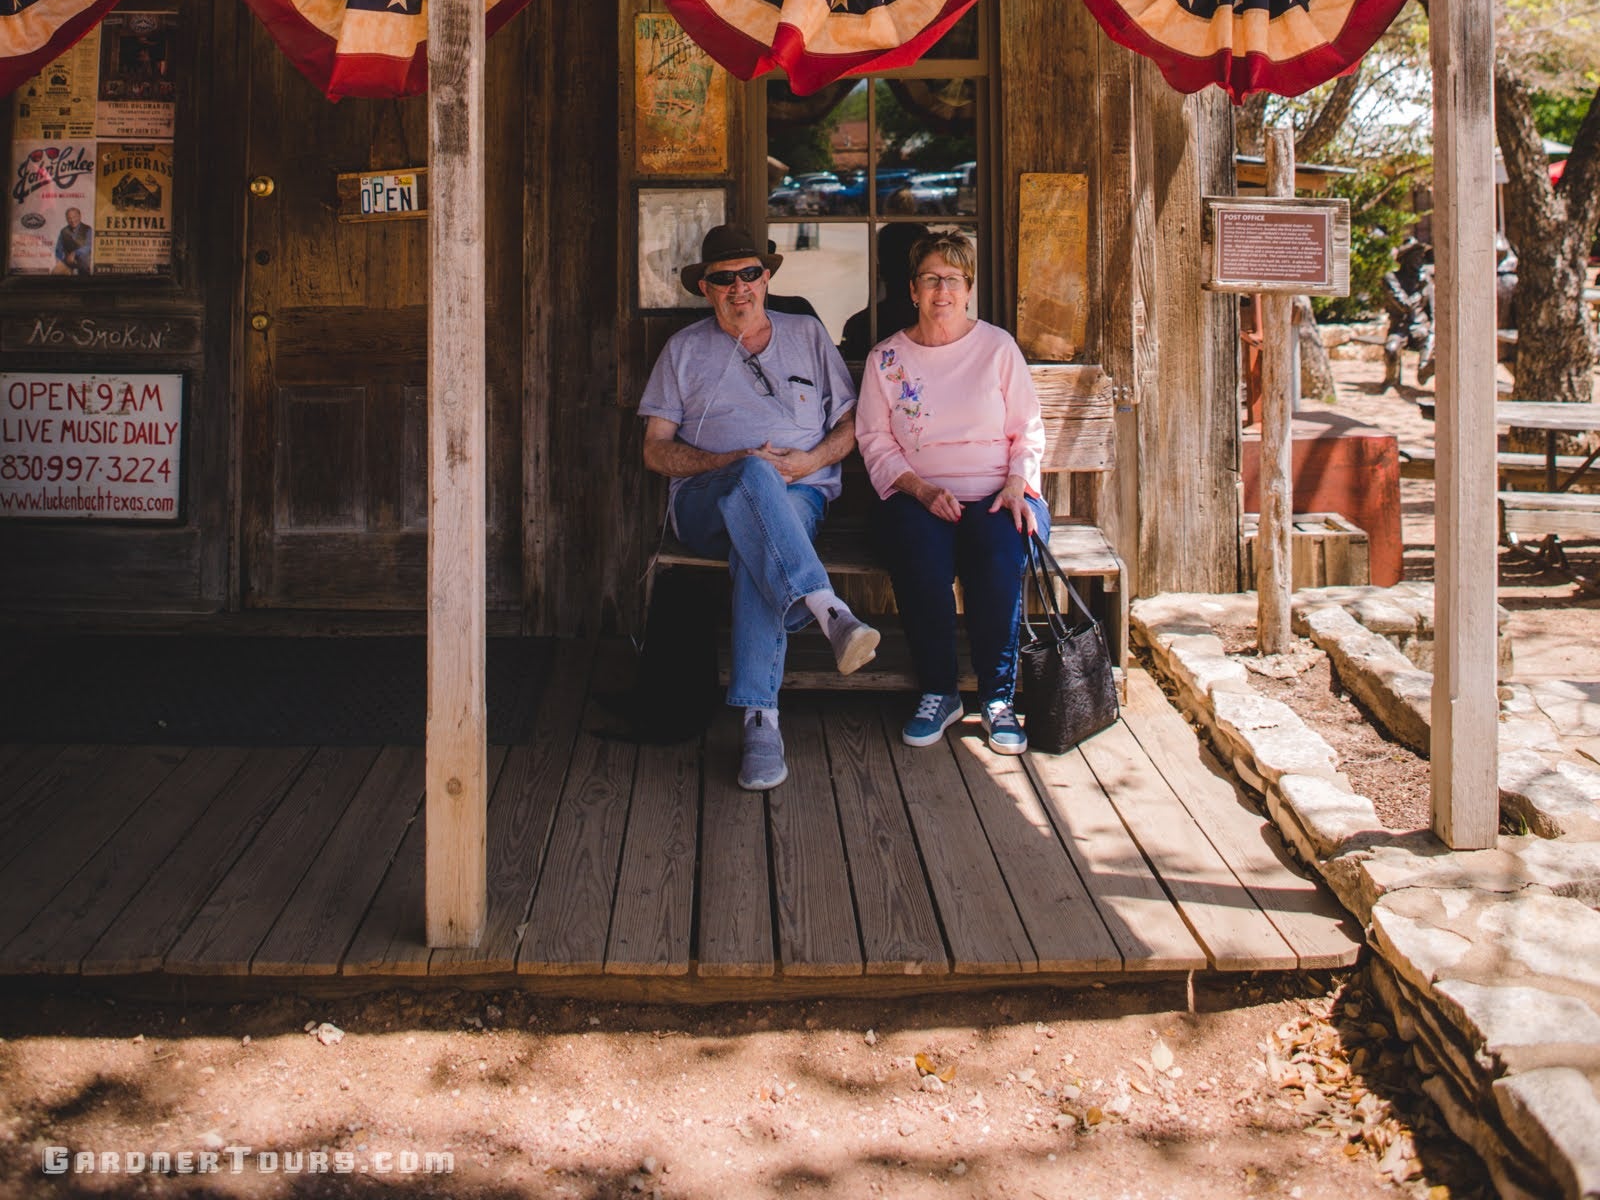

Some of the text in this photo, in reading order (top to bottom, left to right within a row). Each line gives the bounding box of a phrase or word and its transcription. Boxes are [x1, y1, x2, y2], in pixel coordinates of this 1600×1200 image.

[52, 146, 95, 189] Conlee
[103, 157, 174, 178] BLUEGRASS
[361, 182, 413, 214] OPEN
[106, 217, 166, 230] FESTIVAL
[27, 317, 66, 345] No
[8, 381, 163, 412] OPEN 9 AM
[2, 418, 178, 445] LIVE MUSIC DAILY
[0, 485, 174, 513] www.luckenbachtexas.com
